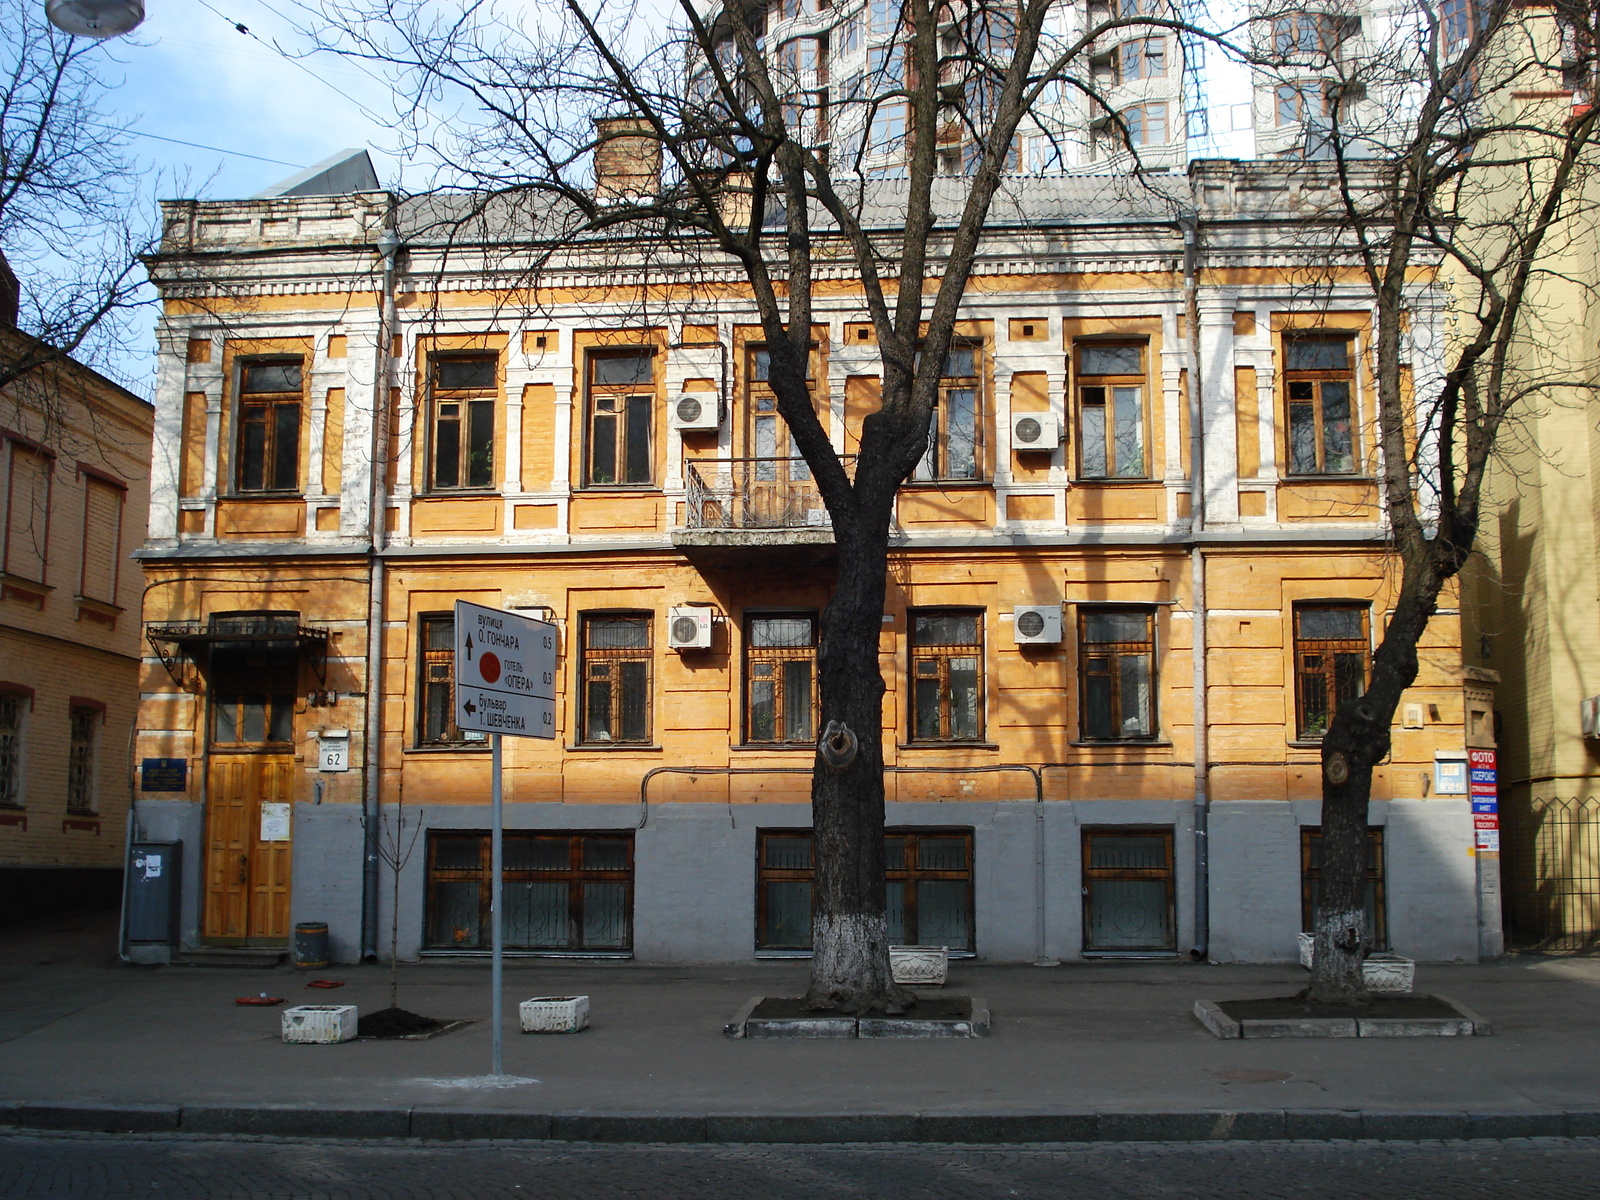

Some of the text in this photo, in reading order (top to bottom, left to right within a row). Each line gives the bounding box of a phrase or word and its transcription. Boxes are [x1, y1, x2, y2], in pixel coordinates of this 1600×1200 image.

[478, 614, 504, 630] вулиця
[478, 629, 520, 651] О. ГОНЧАРА
[504, 674, 534, 691] «ОПЕРА»
[478, 693, 507, 714] бульвар
[479, 711, 526, 730] Т. ШЕВЧЕНКА
[327, 753, 340, 766] 62
[1471, 752, 1494, 763] ФОТО
[1471, 771, 1495, 781] КСЕРОКС
